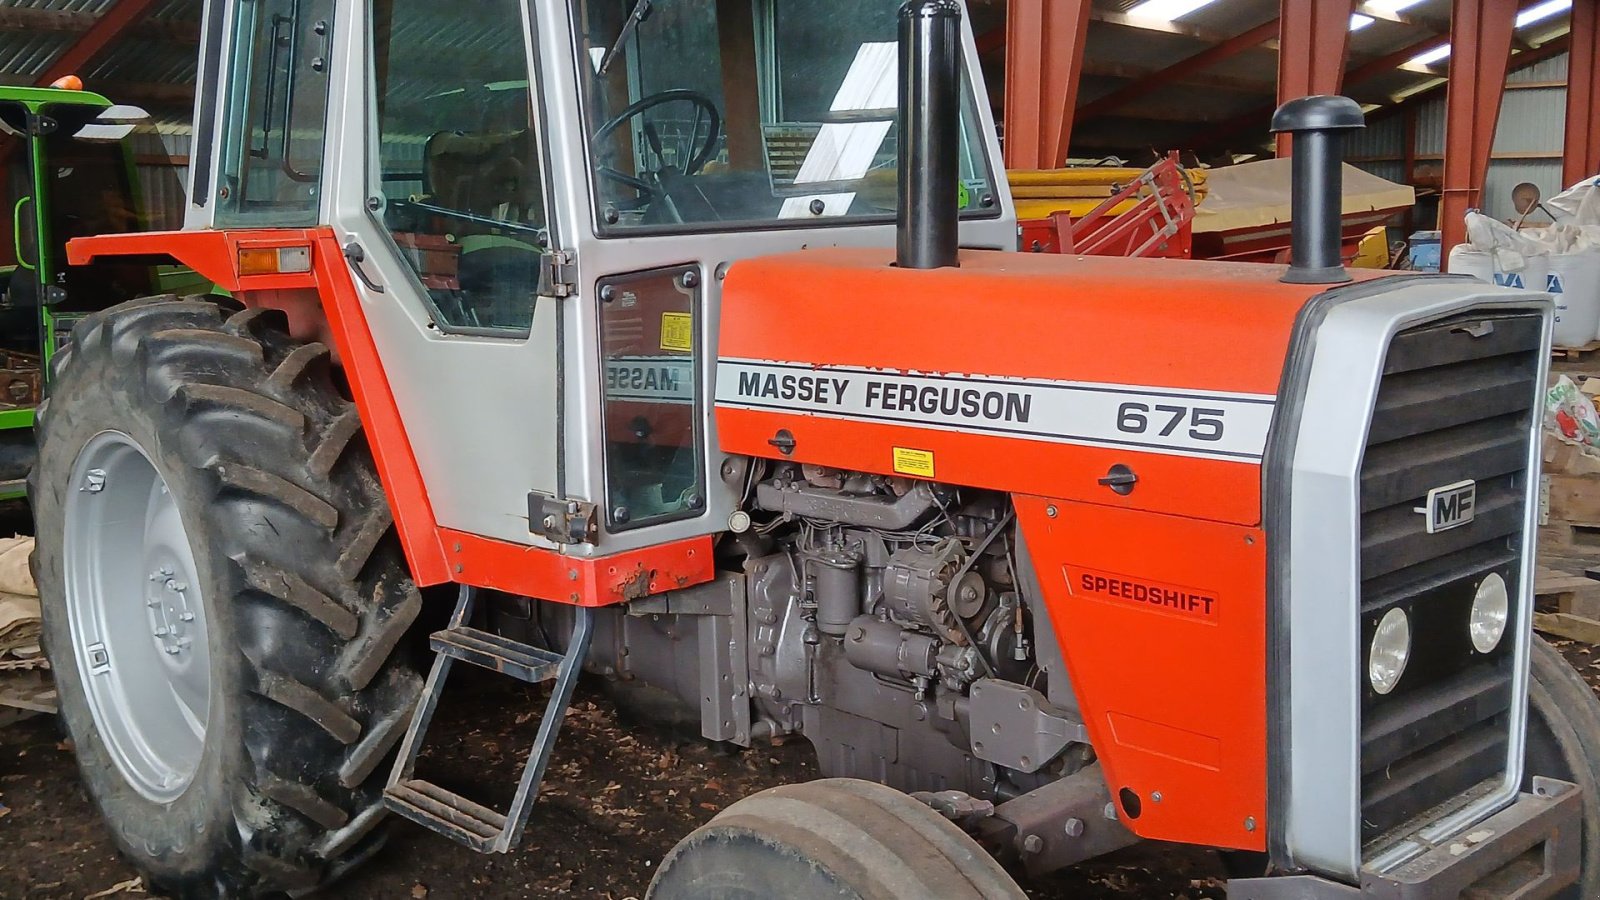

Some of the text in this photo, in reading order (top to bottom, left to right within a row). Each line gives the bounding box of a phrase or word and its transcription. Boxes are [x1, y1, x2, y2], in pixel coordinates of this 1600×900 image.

[738, 371, 1032, 423] MASSEY FERGUSON
[1117, 402, 1225, 442] 675
[1436, 489, 1473, 525] MF
[1082, 574, 1214, 615] SPEEDSHIFT
